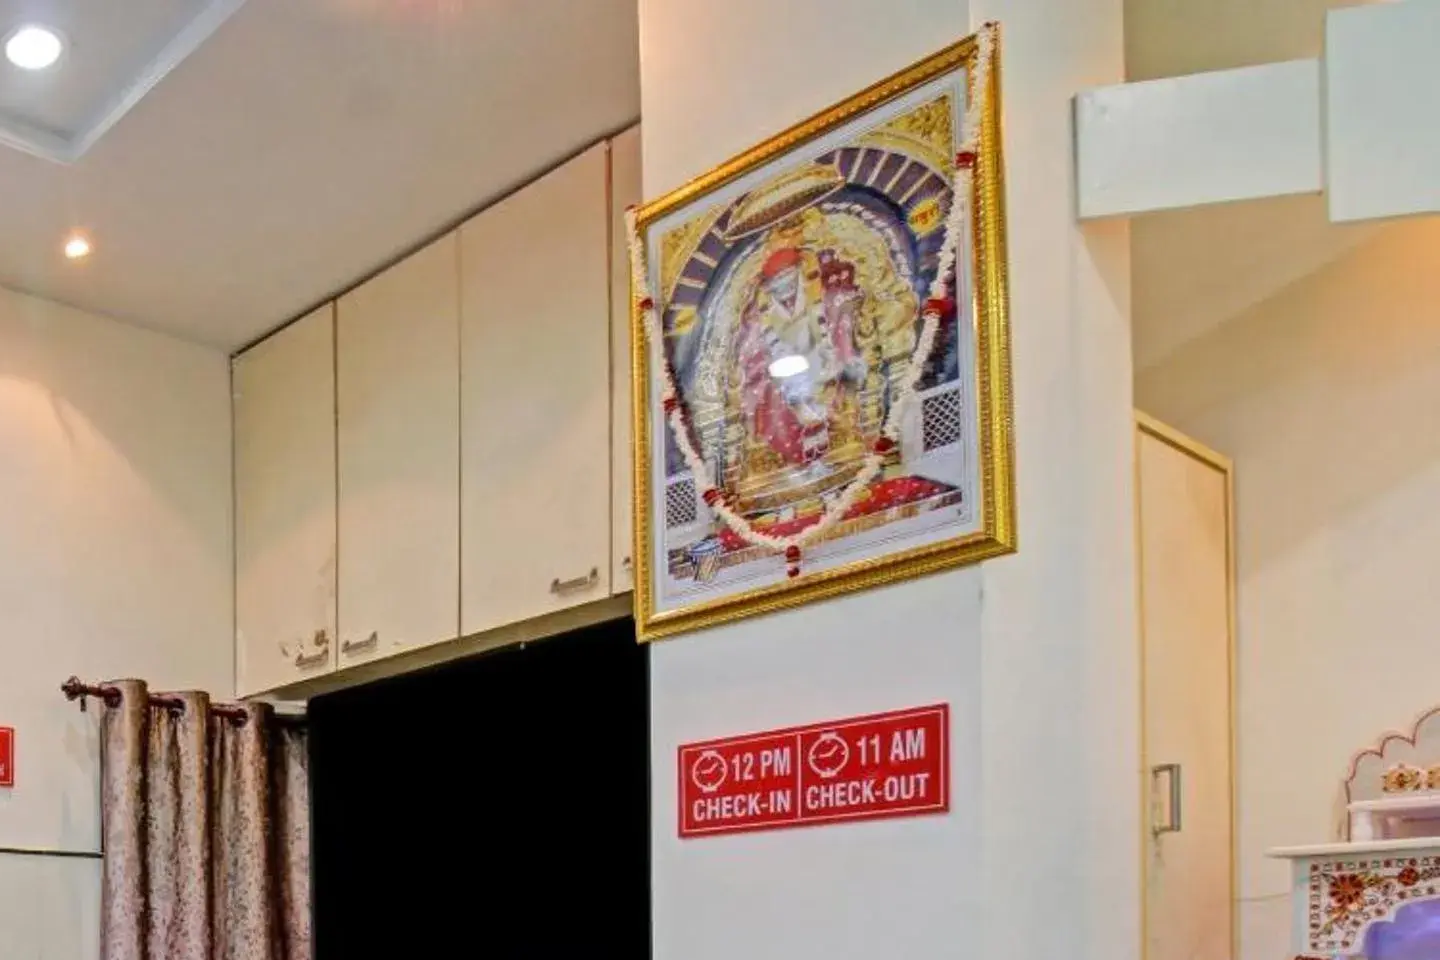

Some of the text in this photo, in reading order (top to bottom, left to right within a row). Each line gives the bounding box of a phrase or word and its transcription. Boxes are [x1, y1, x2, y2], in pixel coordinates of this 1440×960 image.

[731, 747, 791, 782] 12 PM
[857, 727, 926, 766] 11 AM
[693, 790, 791, 822] CHECK-IN
[806, 773, 929, 810] CHECK-OUT
